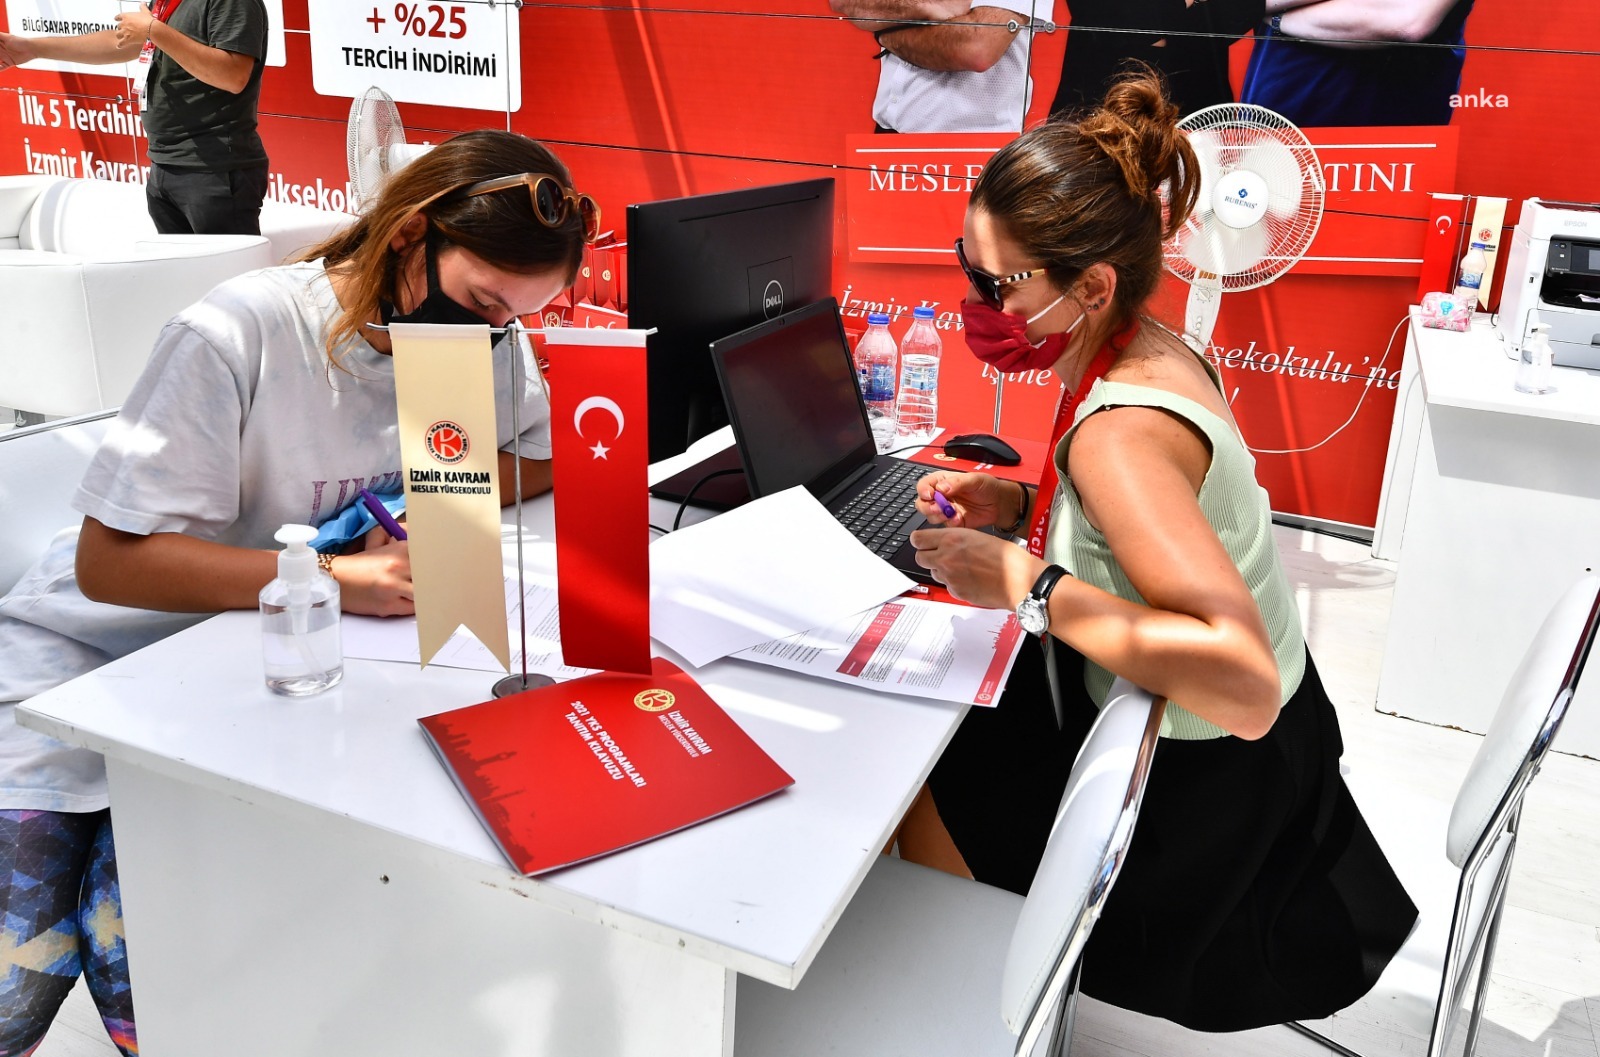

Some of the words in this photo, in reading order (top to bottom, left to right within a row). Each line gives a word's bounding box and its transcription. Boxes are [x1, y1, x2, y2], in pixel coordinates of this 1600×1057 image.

[22, 17, 70, 35] BİLGİSAYAR
[394, 3, 467, 39] %25
[341, 46, 407, 70] TERCİH
[413, 48, 496, 77] İNDİRİMİ
[18, 87, 47, 126] İlk
[50, 99, 62, 128] 5
[24, 137, 77, 178] İzmir
[765, 294, 782, 309] DELL
[839, 284, 908, 322] İzmir
[409, 467, 442, 483] İZMİR
[444, 471, 491, 484] KAVRAM
[410, 484, 439, 493] MESLEK
[440, 484, 491, 495] YÜKSEKOKULU
[564, 711, 594, 742] TANITIM
[587, 740, 625, 780] KILAVUZU
[570, 700, 591, 717] 2021
[585, 716, 603, 732] YKS
[596, 730, 647, 788] PROGRAMLARI
[667, 710, 690, 730] İZMİR
[682, 727, 713, 755] KAVRAM
